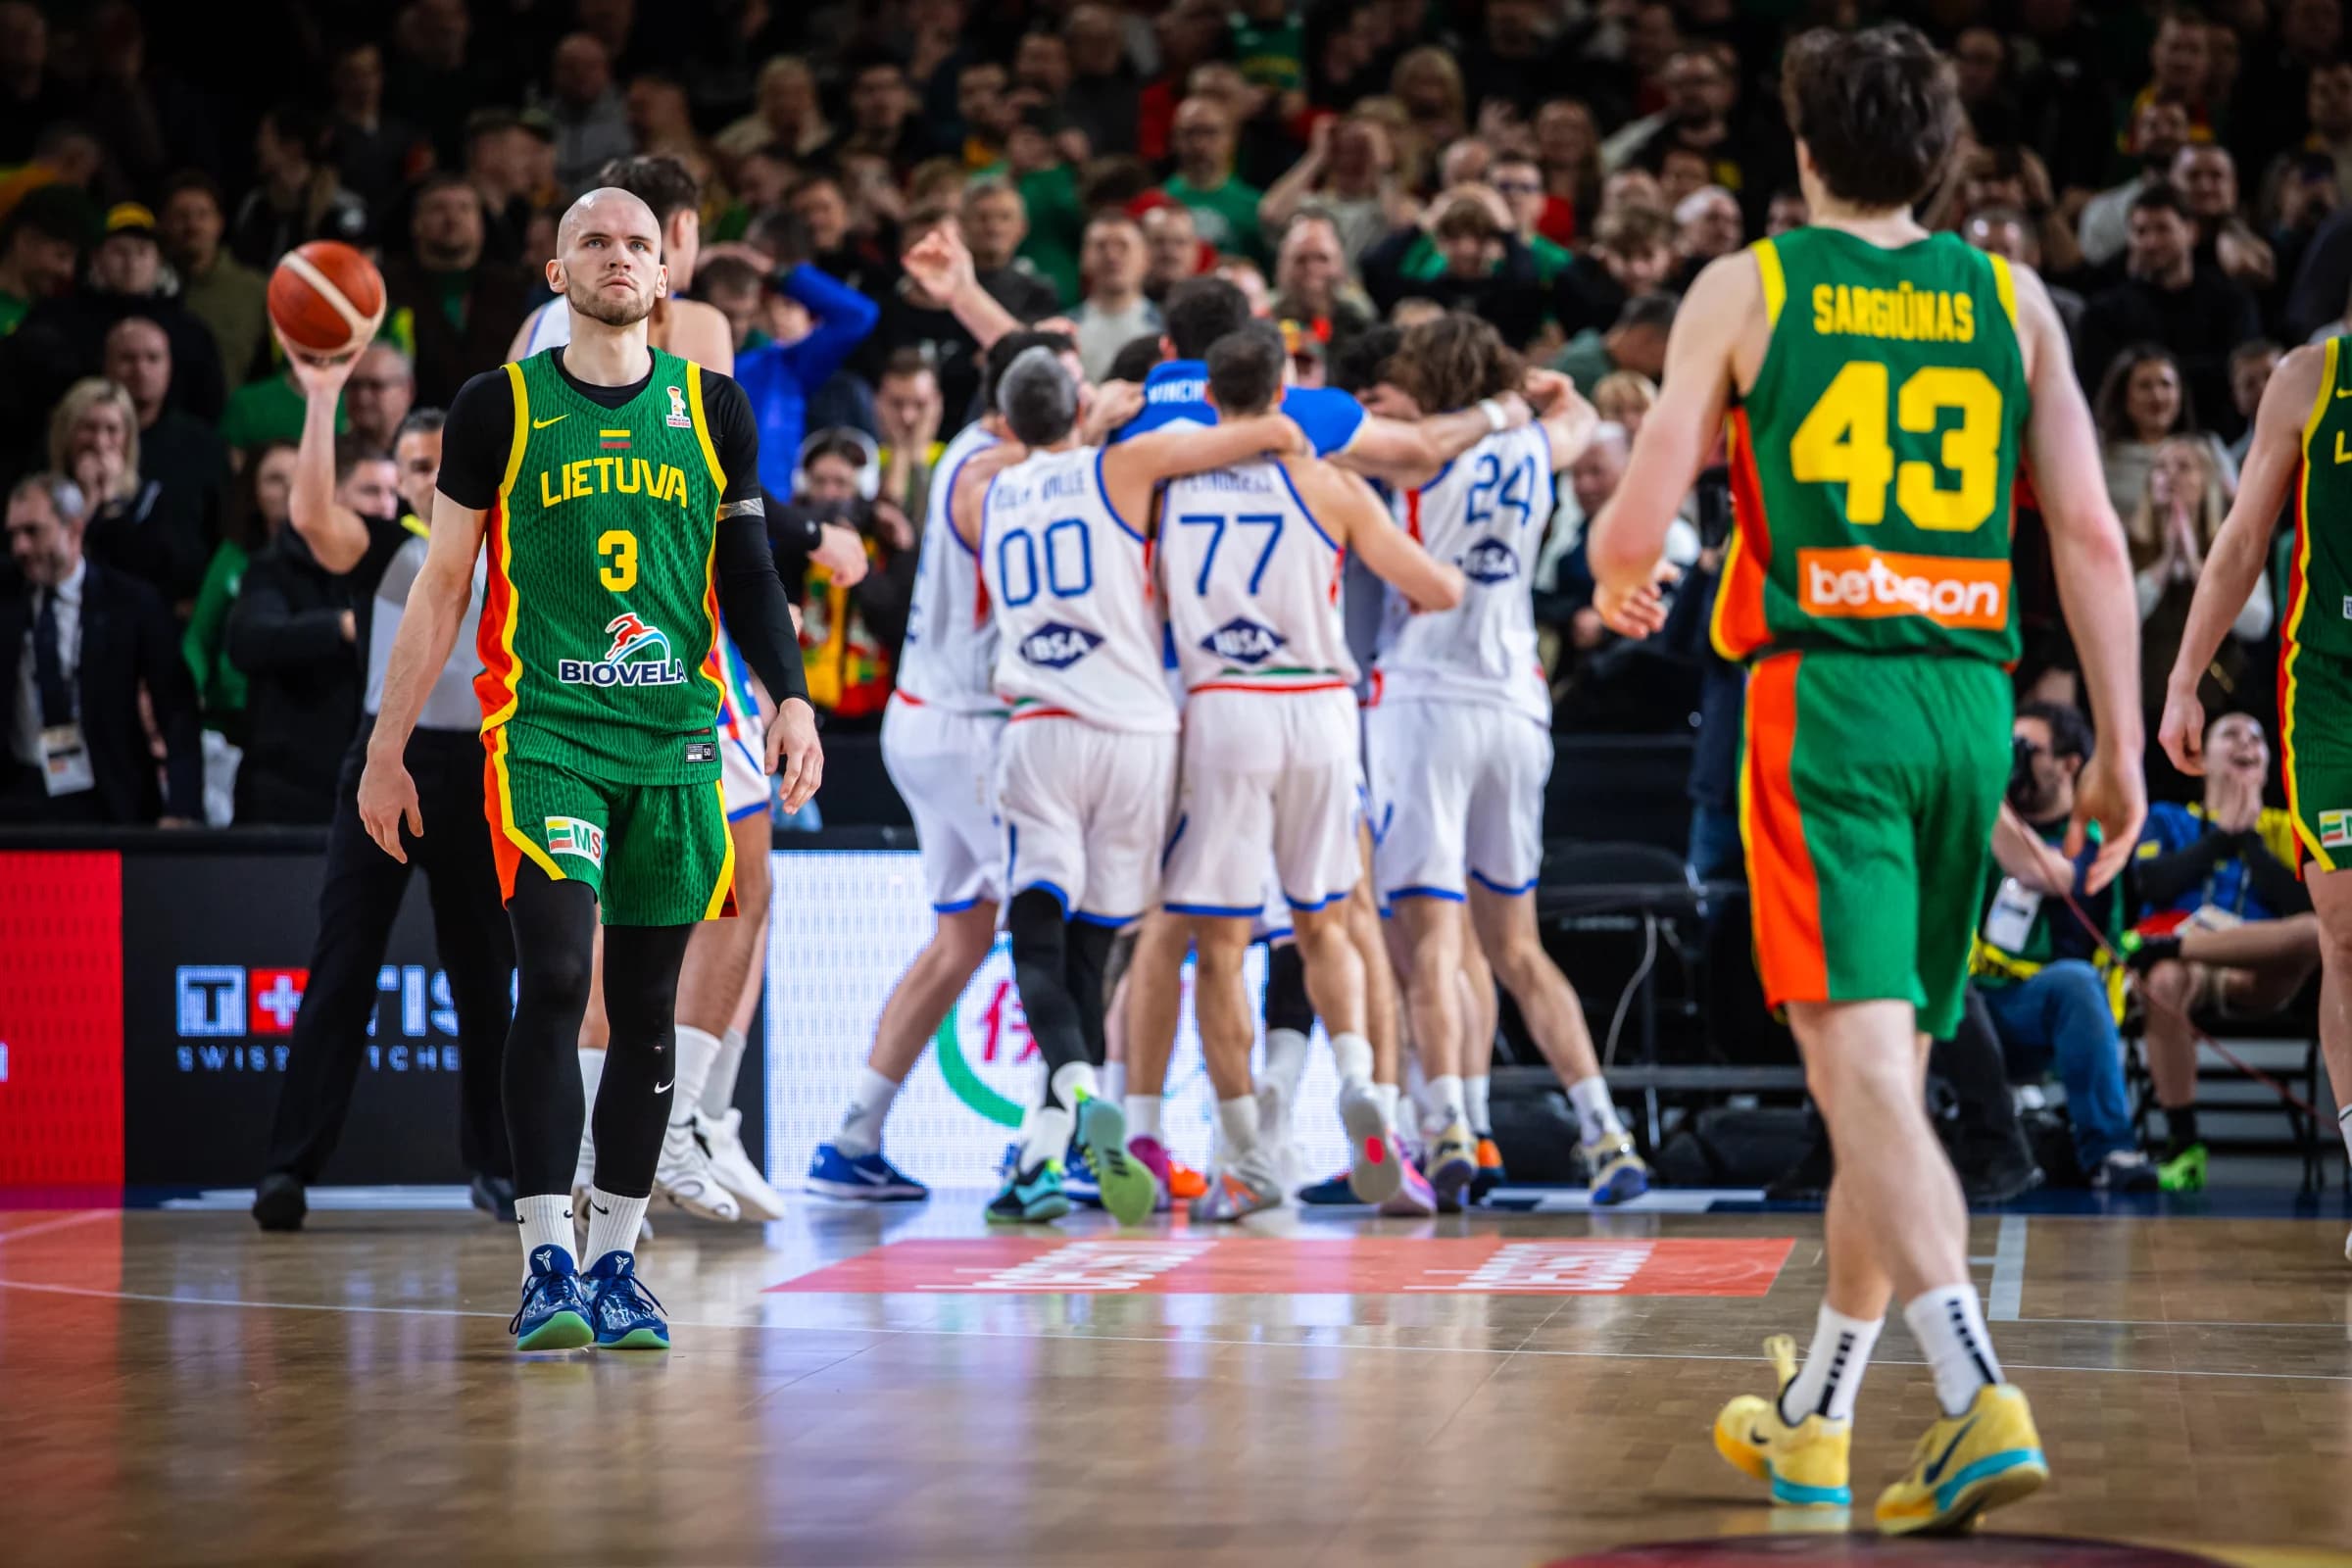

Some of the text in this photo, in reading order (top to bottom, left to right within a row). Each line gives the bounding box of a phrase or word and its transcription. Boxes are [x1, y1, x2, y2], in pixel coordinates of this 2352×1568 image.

[541, 457, 688, 509] LIETUVA
[1789, 360, 2003, 532] 43
[1464, 451, 1537, 528] 24
[598, 530, 637, 592] 3
[998, 517, 1094, 608] 00
[1179, 514, 1285, 596] 77
[559, 659, 688, 687] BIOVELA
